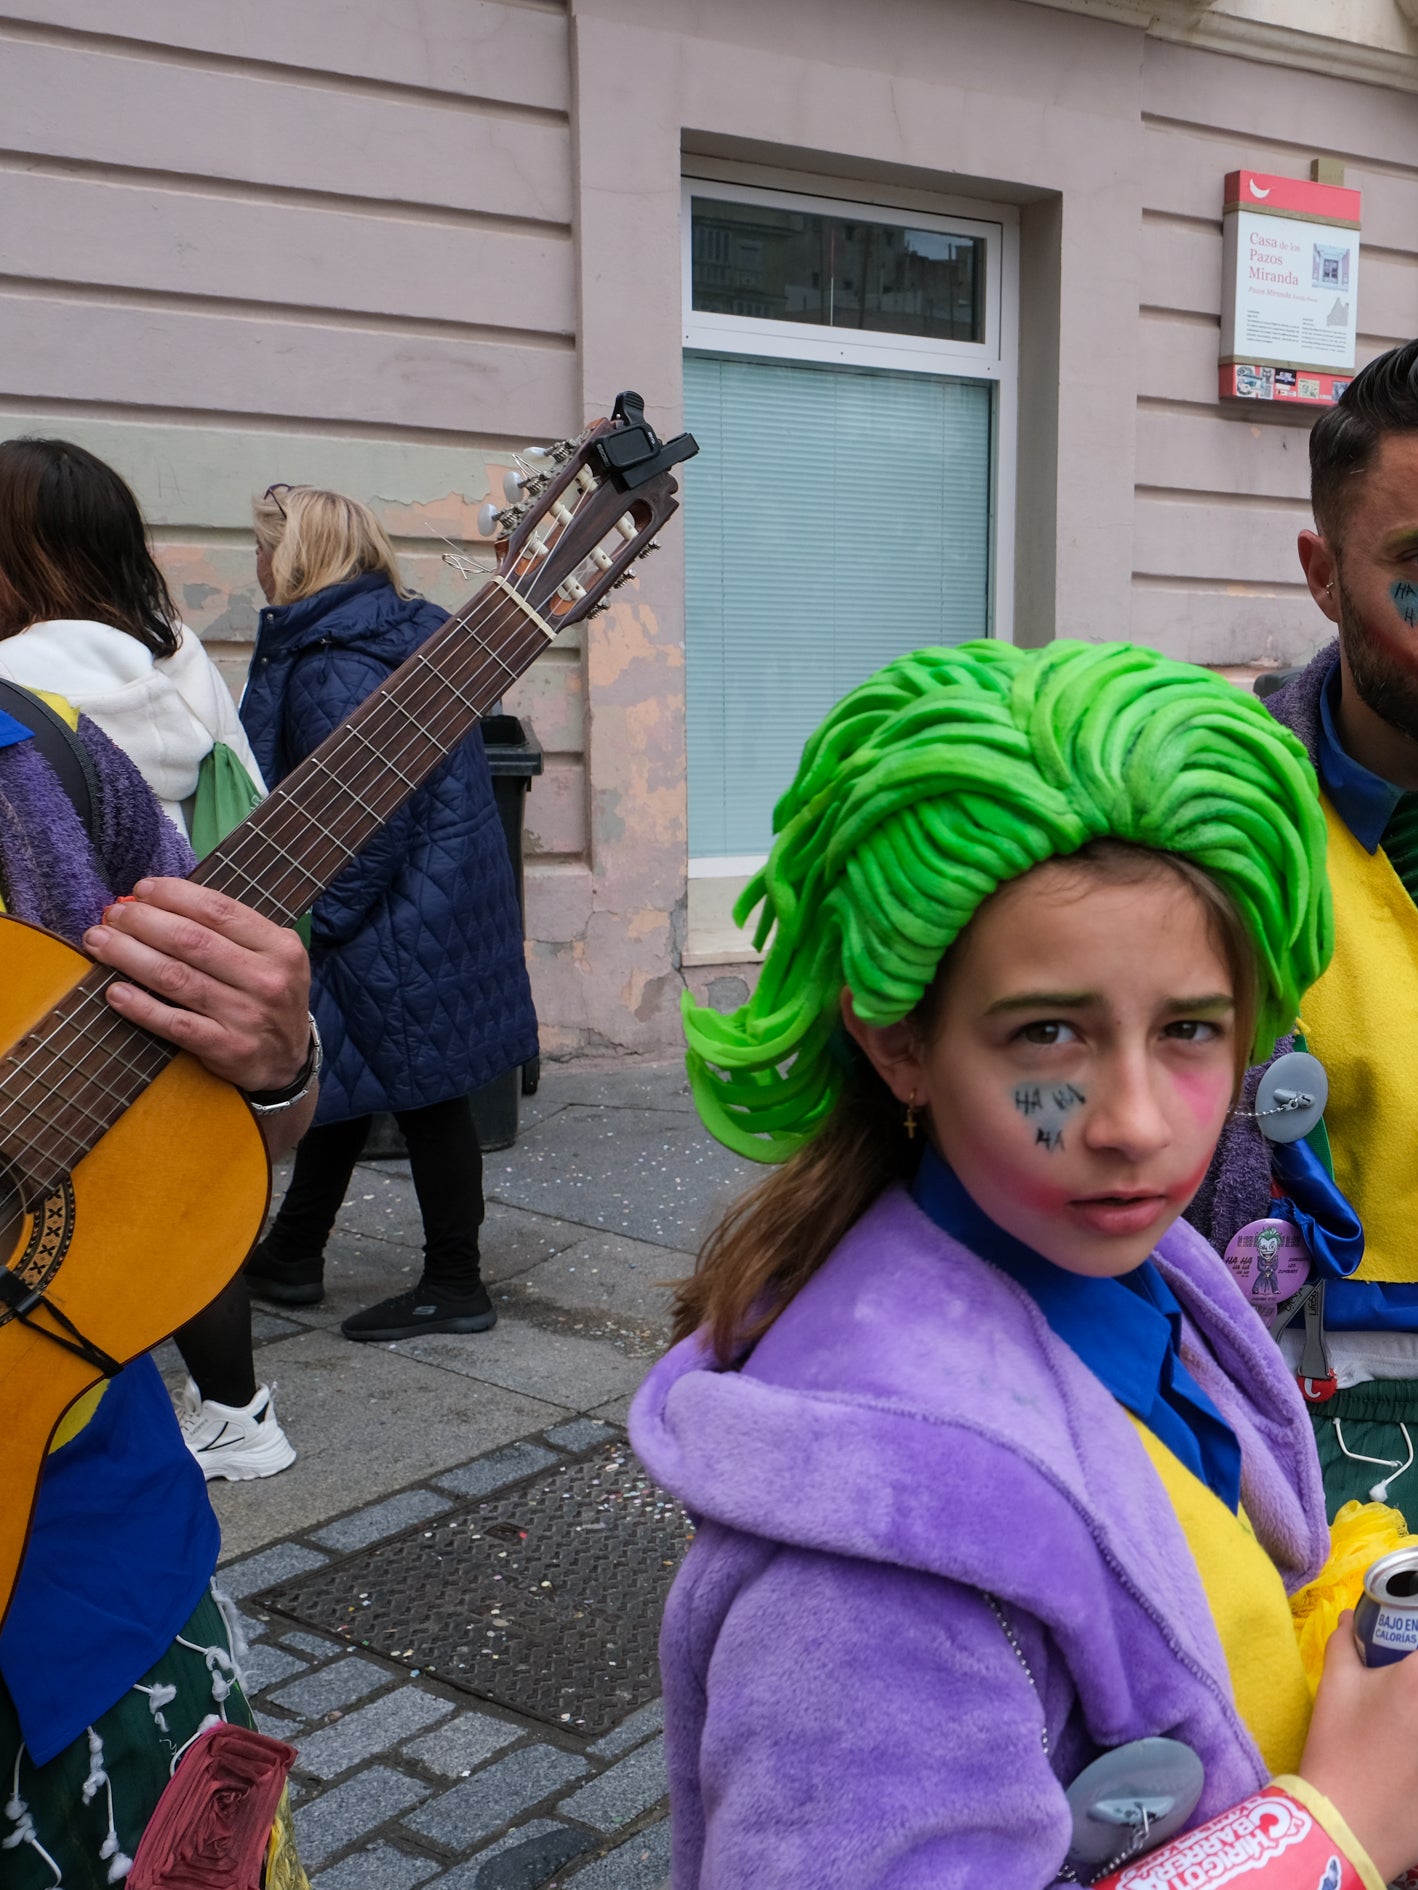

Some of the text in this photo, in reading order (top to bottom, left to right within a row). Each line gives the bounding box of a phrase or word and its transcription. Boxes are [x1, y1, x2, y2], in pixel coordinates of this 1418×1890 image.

[1249, 231, 1277, 248] Casa
[1250, 248, 1283, 265] Pazos
[1249, 265, 1299, 286] Miranda
[1394, 582, 1417, 600] HA
[1015, 1087, 1043, 1116] HA
[1378, 1614, 1418, 1632] BAJO EN
[1375, 1627, 1418, 1645] CALORÍAS
